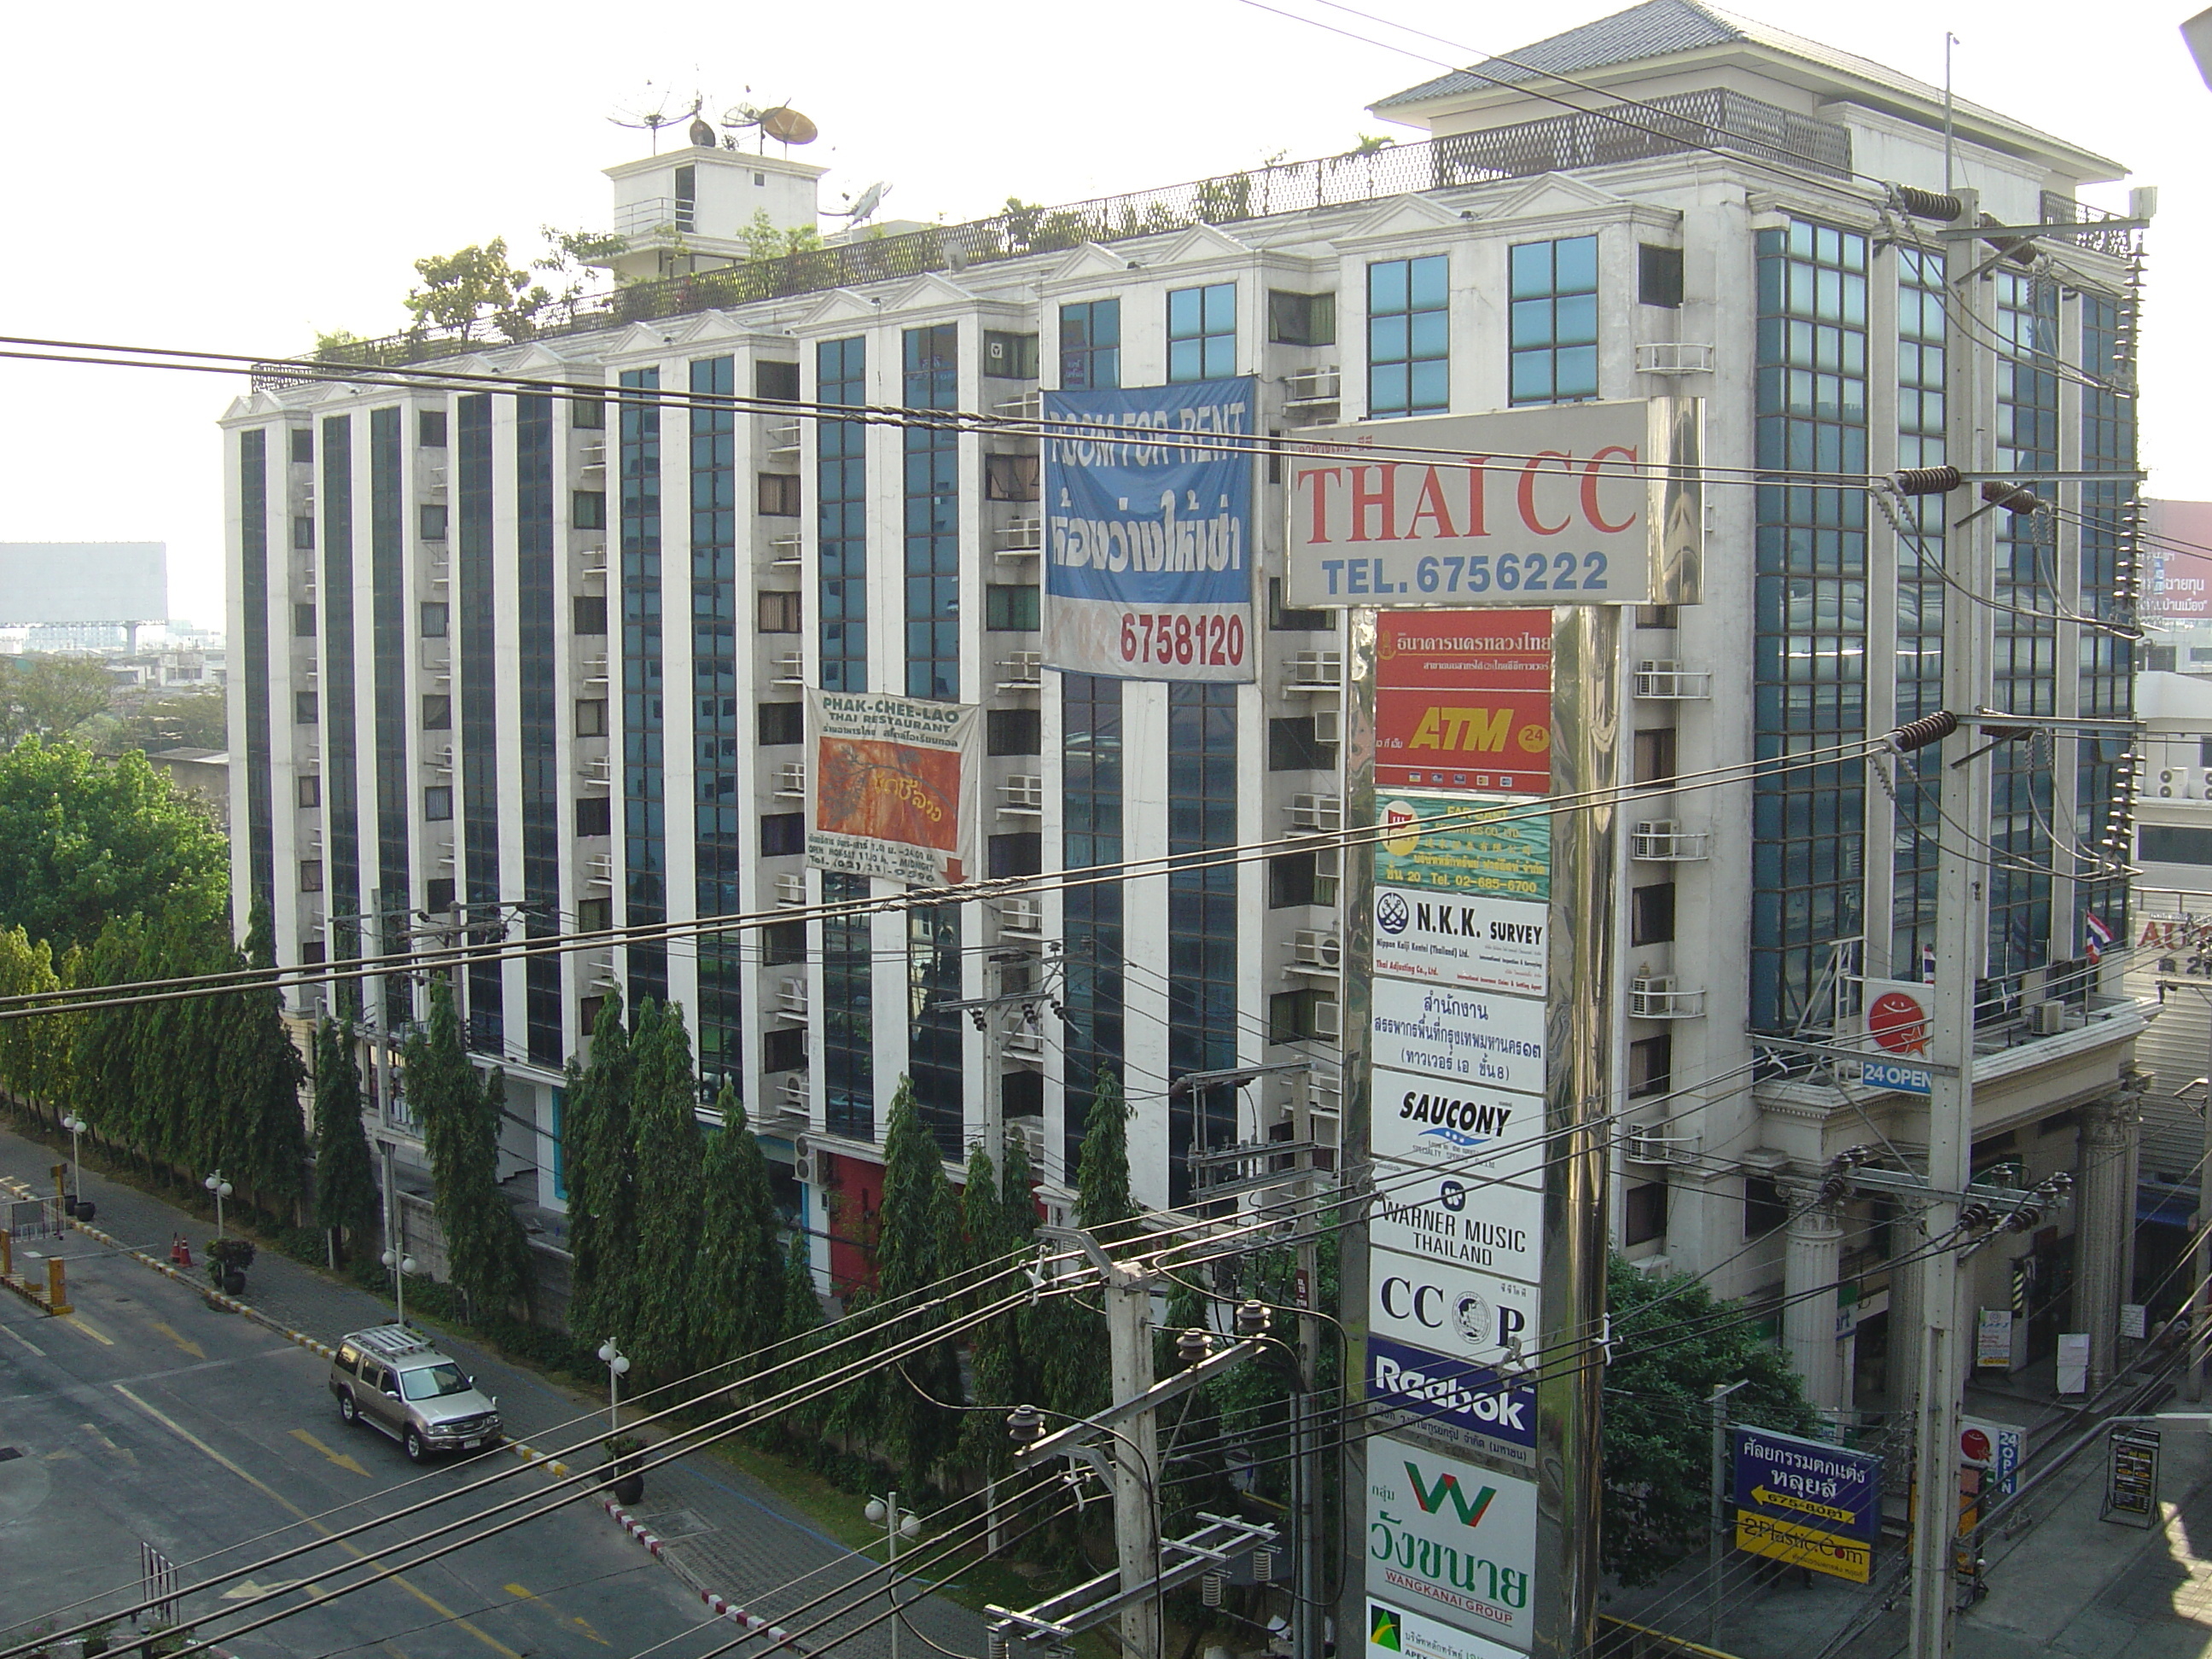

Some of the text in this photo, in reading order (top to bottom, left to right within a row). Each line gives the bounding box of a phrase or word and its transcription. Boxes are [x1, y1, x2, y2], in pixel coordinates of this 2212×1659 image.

[1049, 401, 1246, 467] ROOM FOR RENT
[1297, 444, 1639, 544] THAI CC
[1050, 487, 1240, 573] ห้องว่างให้เช่า
[1120, 613, 1244, 667] 6758120
[1397, 632, 1551, 651] ธนาคารนครหลวงไทย
[823, 696, 960, 724] PHAK-CHEE-LAO
[829, 712, 951, 733] THAI RESTAURANT
[1408, 707, 1515, 753] ATM
[1524, 728, 1545, 742] 24
[899, 858, 934, 872] MIDNIGHT
[1408, 870, 1421, 882] 20
[1430, 872, 1450, 886] Tel.
[1455, 875, 1537, 893] 02-685-6700
[1417, 901, 1543, 946] N.K.K. SURVEY
[1377, 938, 1395, 949] Nippon
[1429, 944, 1458, 958] (Thailand)
[1458, 948, 1470, 958] Ltd.
[1377, 959, 1388, 969] Thai
[1389, 961, 1415, 975] Adjusting
[1428, 967, 1439, 976] Ltd.
[1423, 989, 1489, 1021] สำนักงาน
[1400, 1047, 1453, 1071] (ทาวเวอร์
[1458, 1058, 1470, 1074] เอ
[1864, 1063, 1932, 1088] 24 OPEN
[1399, 1091, 1512, 1138] SAUCONY
[1382, 1196, 1527, 1254] WARNER MUSIC
[1412, 1231, 1493, 1266] THAILAND
[1375, 1354, 1526, 1432] Reebok
[1464, 1432, 1485, 1448] จำกัด
[1489, 1441, 1527, 1462] (มหาชน)
[2000, 1432, 2019, 1447] 24
[1743, 1436, 1866, 1485] ศัลยกรรมตกแต่ง
[1371, 1481, 1396, 1503] กลุ่ม
[1371, 1510, 1529, 1610] วังขนาย
[1385, 1569, 1513, 1624] WANGKANAI GROUP
